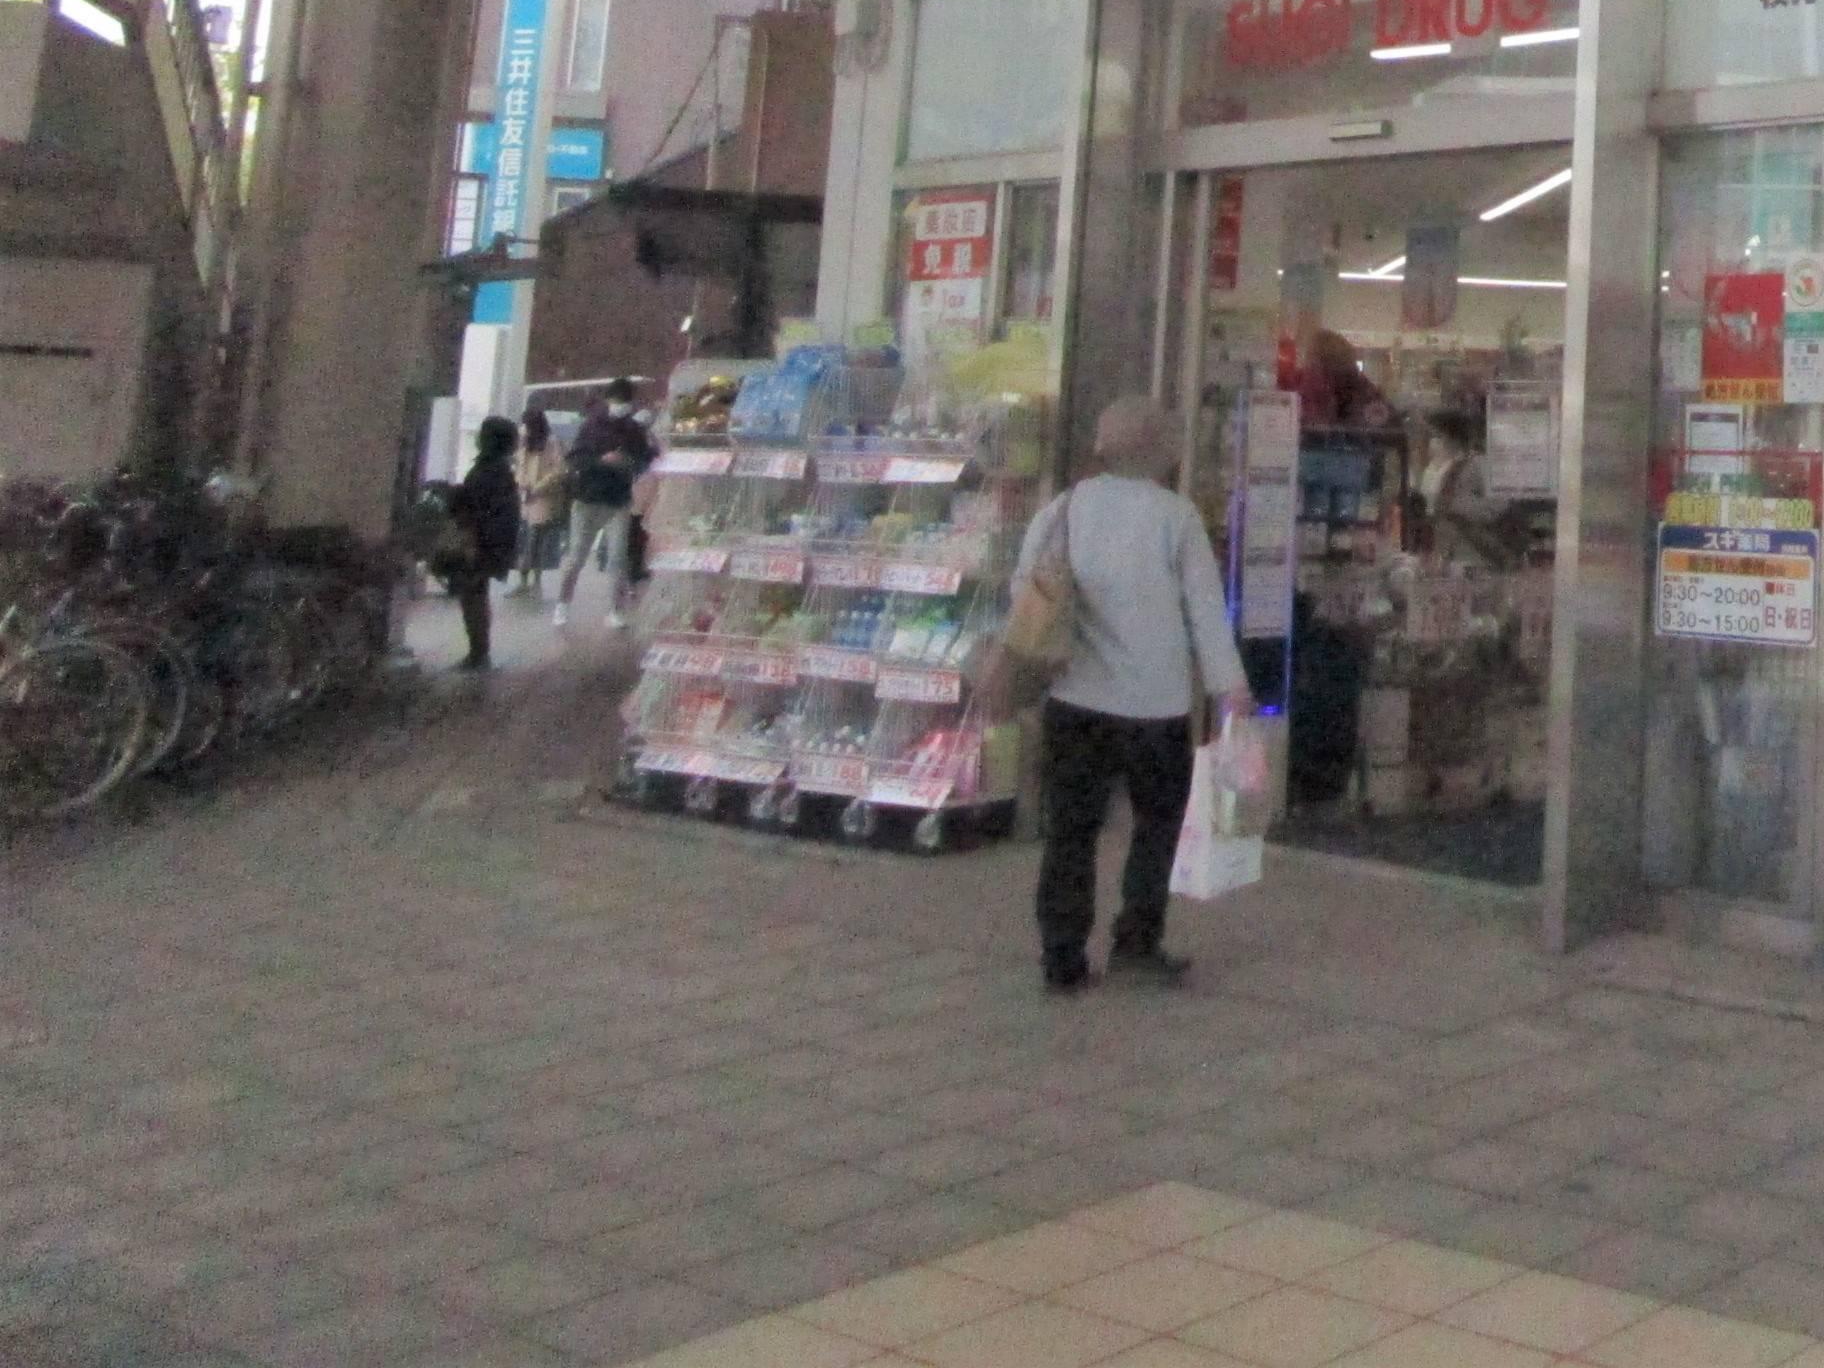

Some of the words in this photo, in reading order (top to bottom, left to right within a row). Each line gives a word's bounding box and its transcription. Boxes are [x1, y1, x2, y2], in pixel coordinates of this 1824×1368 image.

[491, 29, 536, 240] 三井住友信託銀
